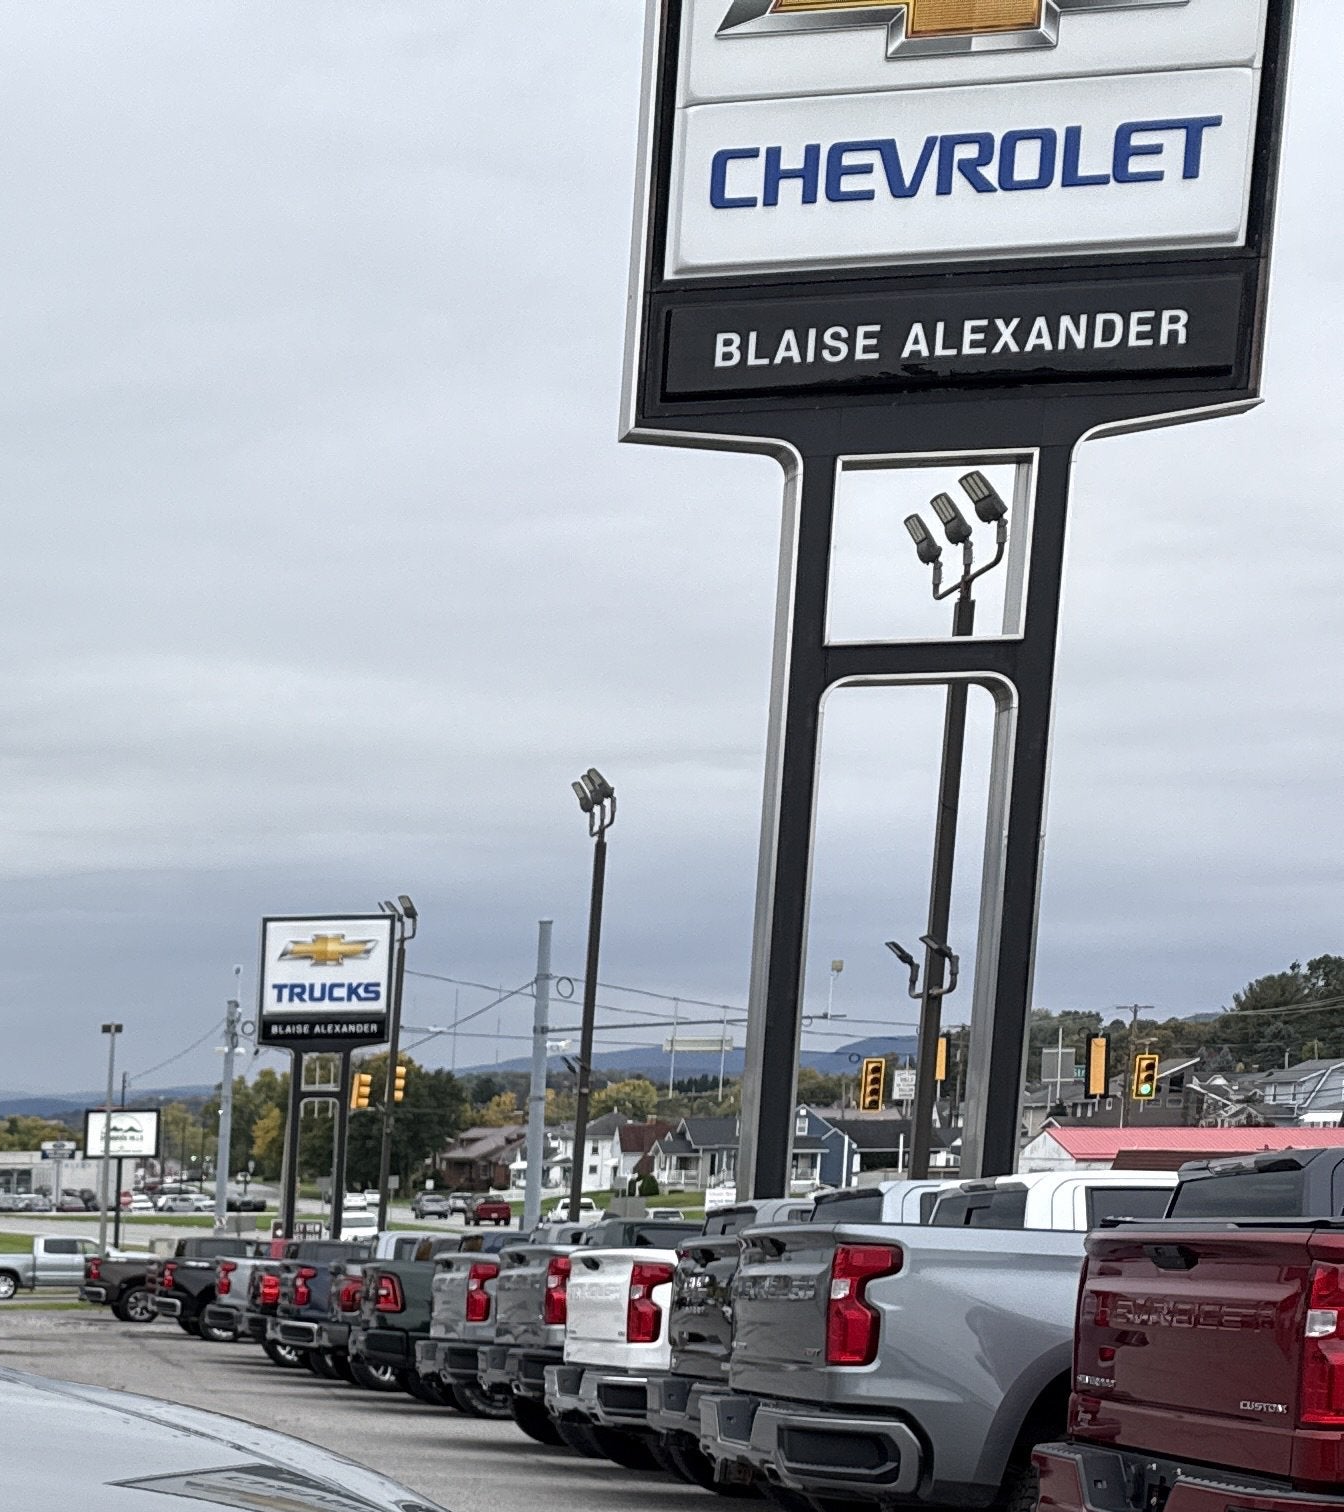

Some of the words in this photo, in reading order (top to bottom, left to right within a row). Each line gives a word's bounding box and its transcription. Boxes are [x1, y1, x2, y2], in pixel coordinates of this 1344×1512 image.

[709, 114, 1223, 209] CHEVROLET
[714, 324, 882, 368] BLAISE
[900, 308, 1190, 360] ALEXANDER
[272, 982, 381, 1003] TRUCKS
[271, 1023, 310, 1035] BLAISE
[313, 1023, 378, 1035] ALEXANDER
